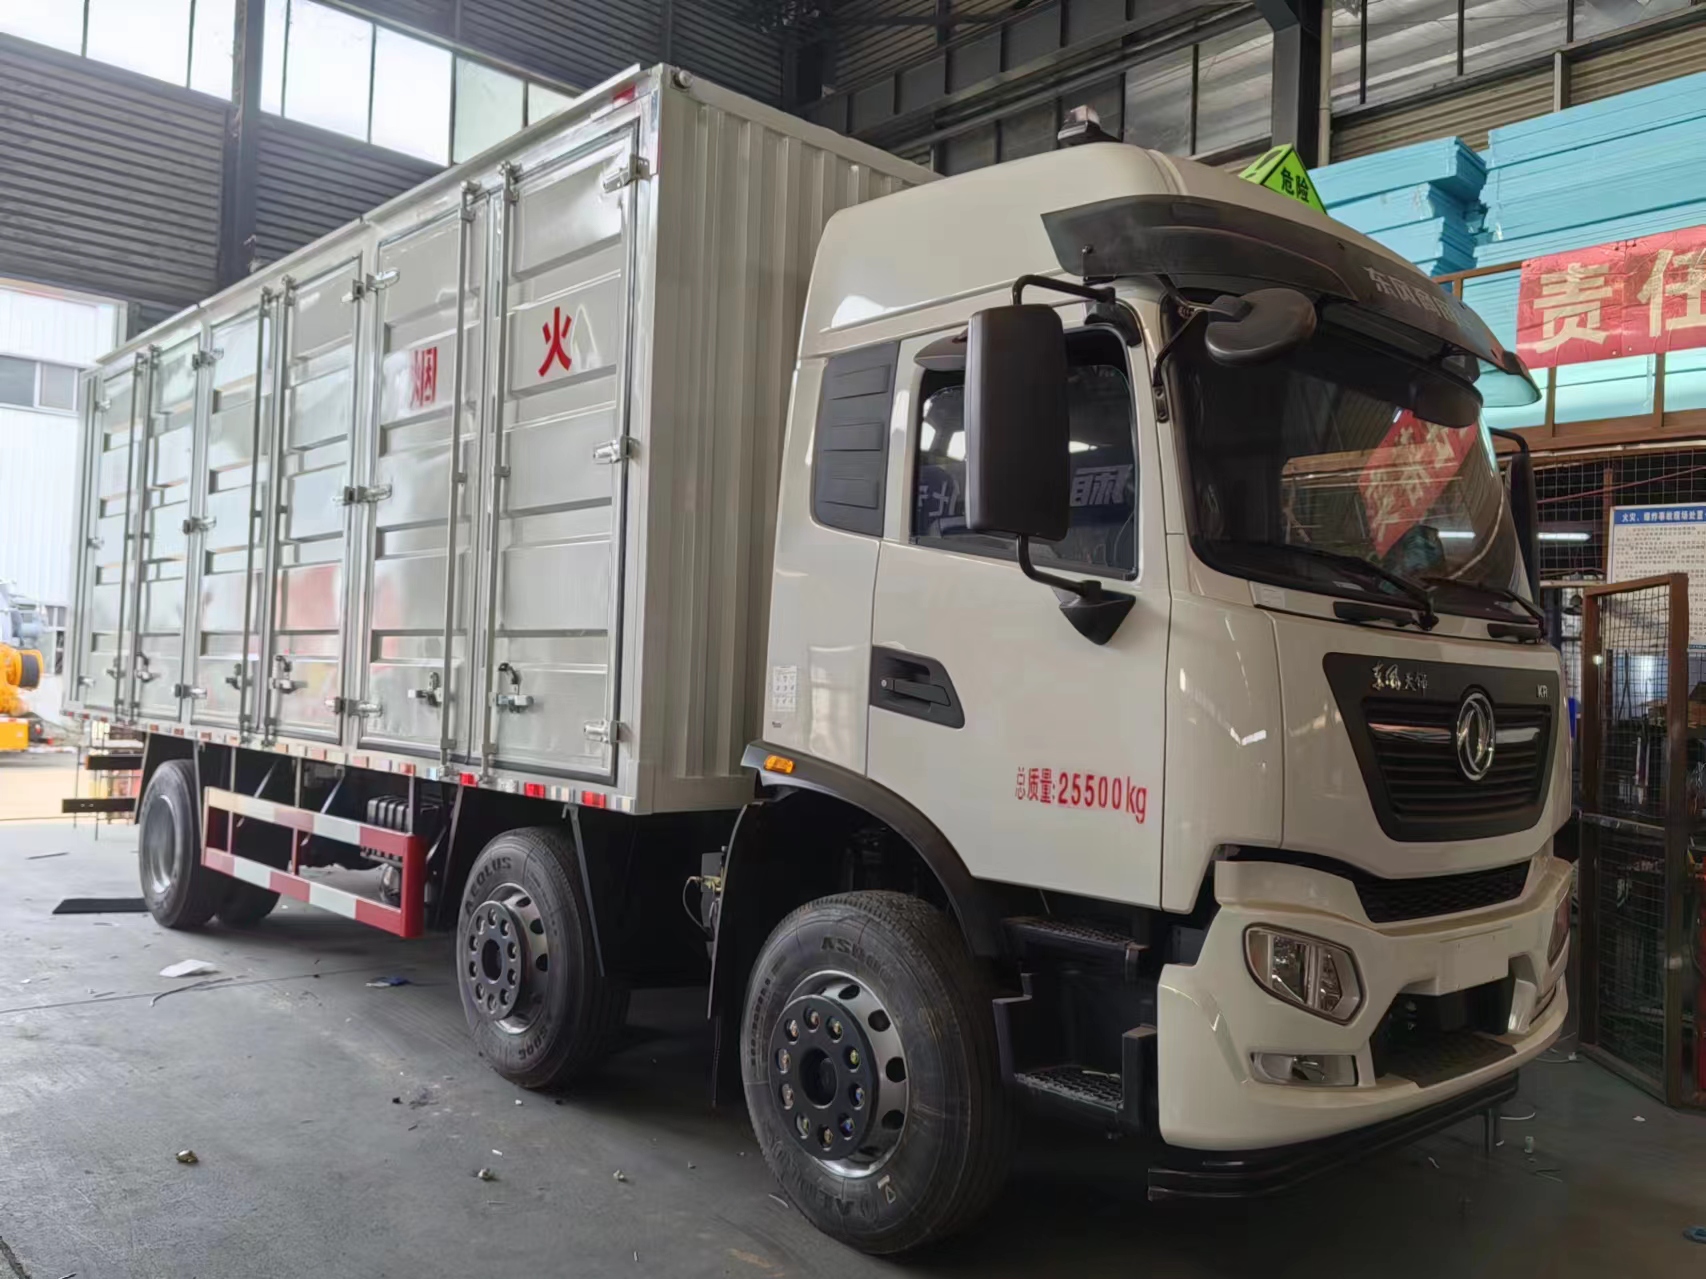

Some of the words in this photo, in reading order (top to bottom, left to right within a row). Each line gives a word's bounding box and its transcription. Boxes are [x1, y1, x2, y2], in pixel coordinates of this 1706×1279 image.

[1280, 166, 1310, 203] 危险
[538, 306, 573, 377] 火
[465, 856, 512, 917] AEOLUS
